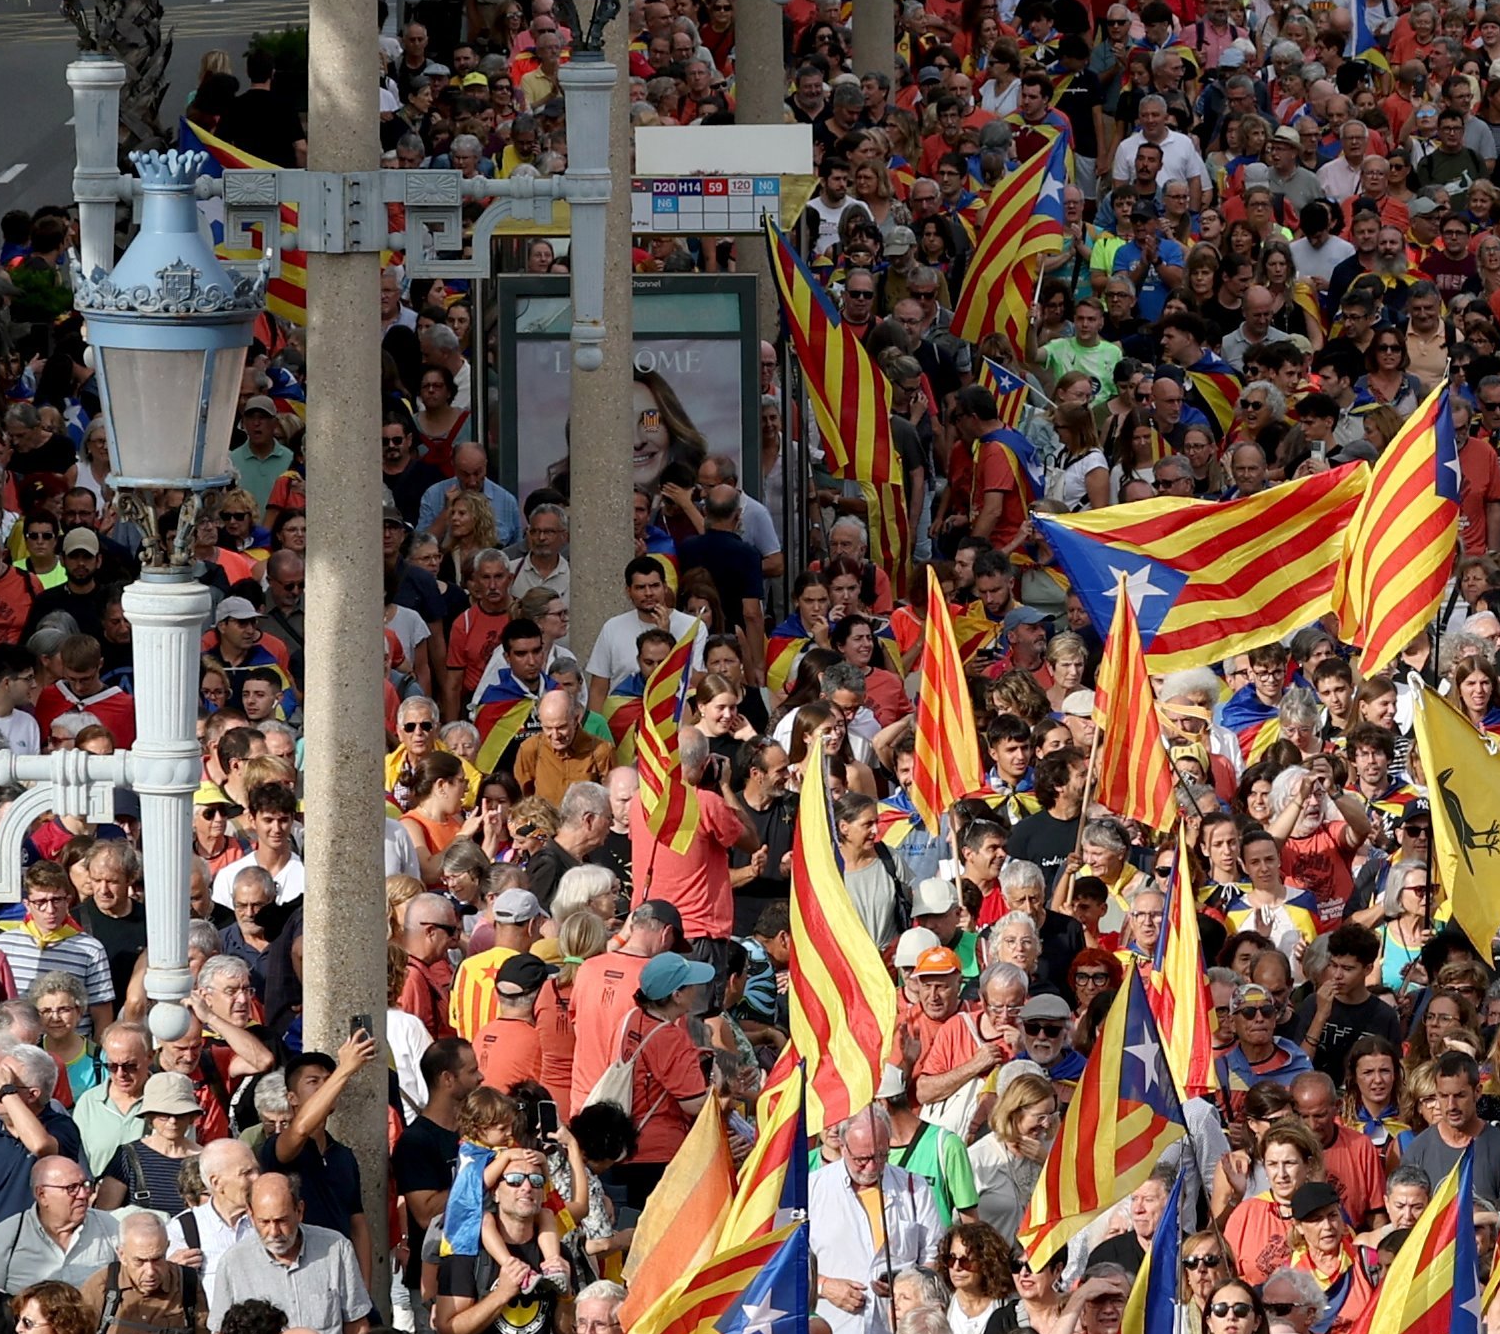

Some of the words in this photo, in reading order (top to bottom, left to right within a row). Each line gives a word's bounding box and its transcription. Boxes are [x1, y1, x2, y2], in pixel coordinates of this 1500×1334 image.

[653, 180, 676, 193] D20
[679, 180, 702, 193] H14
[708, 181, 723, 193] 59
[732, 180, 750, 190] 120
[759, 181, 773, 191] N0
[657, 198, 672, 208] N6
[632, 278, 661, 289] hannel
